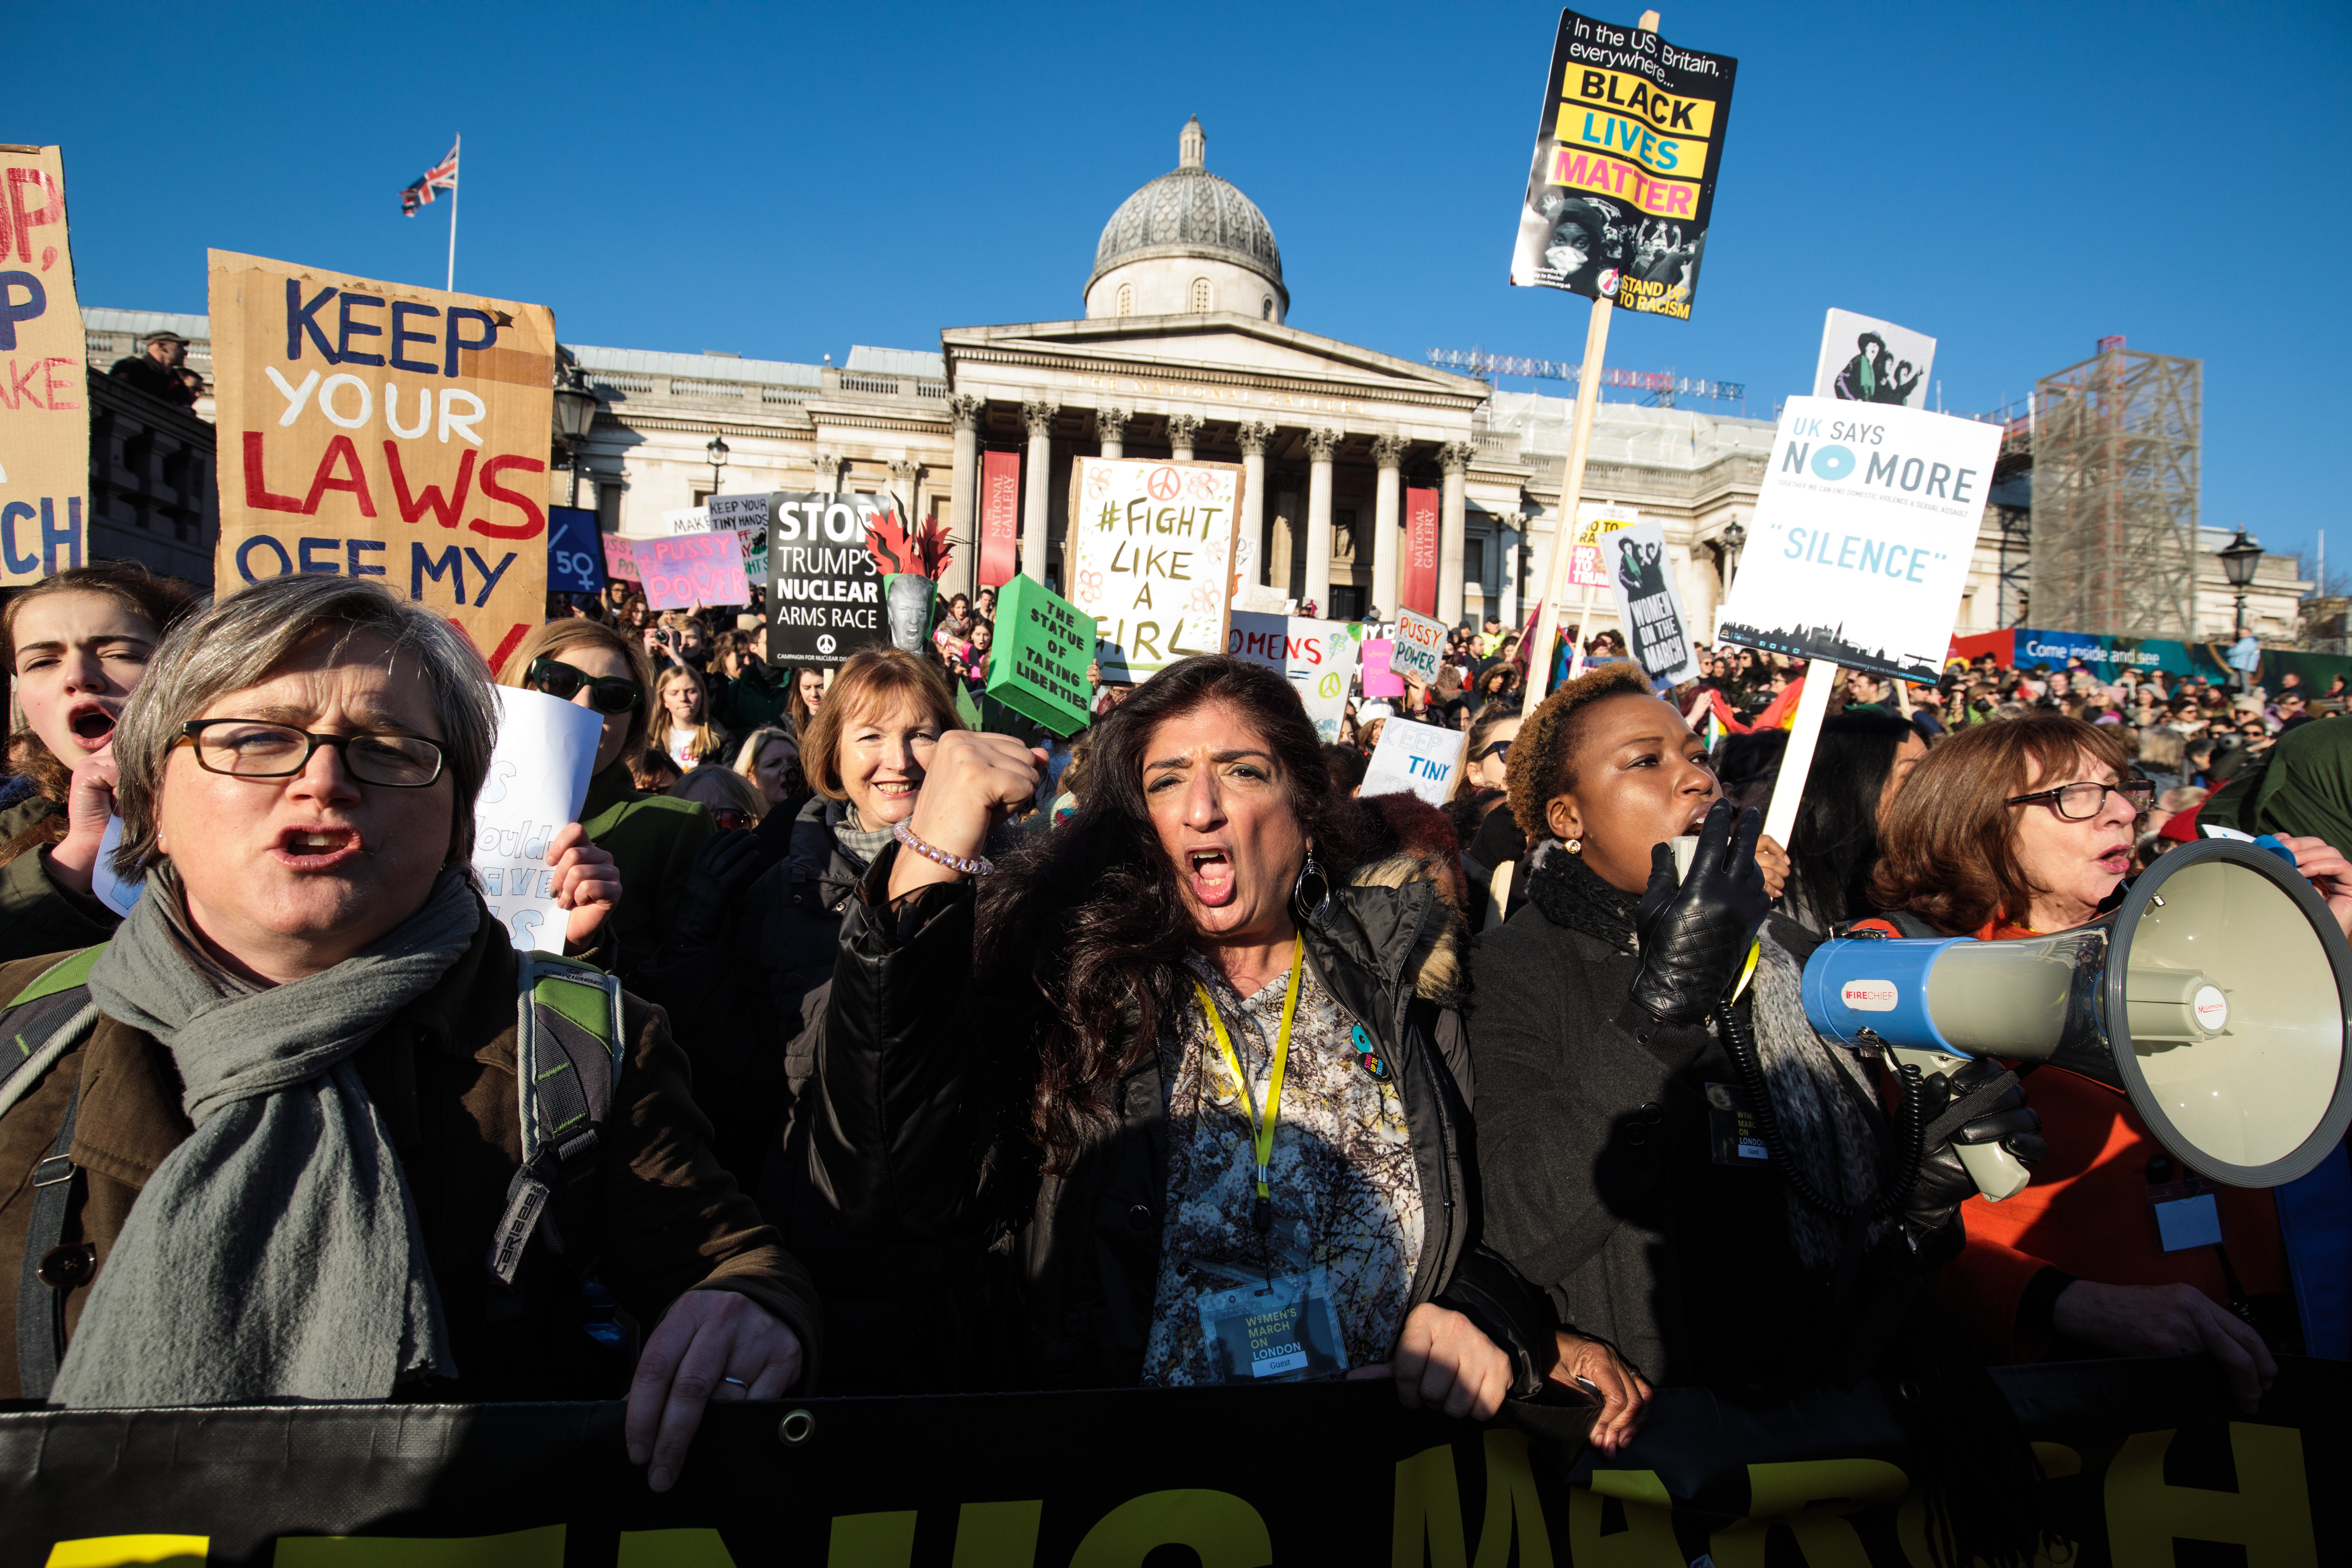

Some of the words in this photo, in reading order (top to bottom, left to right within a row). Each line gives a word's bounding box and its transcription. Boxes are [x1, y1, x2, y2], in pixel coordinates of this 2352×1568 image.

[1570, 42, 1674, 87] everywhere...
[1574, 18, 1589, 39] In
[1596, 25, 1624, 46] the
[1631, 31, 1657, 58] US,
[1662, 44, 1719, 77] Britain,
[1580, 70, 1698, 130] BLACK
[1582, 112, 1679, 170] LIVES
[1553, 150, 1693, 215] MATTER
[1620, 289, 1634, 308] TO
[1636, 295, 1691, 319] RACISM
[1621, 274, 1663, 297] STAND
[1667, 284, 1686, 301] UP
[286, 278, 498, 377] KEEP
[265, 366, 487, 447] YOUR
[1134, 380, 1250, 402] NATIONAL
[1793, 417, 1823, 437] UK
[1830, 421, 1885, 445] SAYS
[243, 431, 546, 540] LAWS
[1782, 441, 1856, 481] NO
[1865, 451, 1977, 504] MORE
[710, 501, 739, 515] KEEP
[741, 498, 767, 513] YOUR
[992, 474, 1003, 537] NATIONAL
[1001, 474, 1014, 538] GALLERY
[1778, 479, 1807, 489] TOGETHER
[1819, 486, 1831, 494] CAN
[1847, 490, 1877, 500] DOMESTIC
[1880, 495, 1909, 506] VIOLENCE
[1916, 501, 1939, 512] SEXUAL
[1940, 506, 1968, 517] ASSAULT
[711, 515, 736, 531] TINY
[1094, 497, 1224, 542] #FIGHT
[654, 535, 732, 562] PUSSY
[1414, 508, 1424, 567] NATIONAL
[1423, 509, 1435, 568] GALLERY
[1576, 547, 1595, 560] NO
[411, 541, 518, 608] MY
[778, 546, 877, 576] TRUMP'S
[1110, 540, 1194, 581] LIKE
[1575, 559, 1593, 572] TO
[648, 566, 749, 609] POWER
[777, 578, 878, 603] NUCLEAR
[1133, 581, 1153, 610] A
[777, 606, 826, 627] ARMS
[832, 608, 877, 628] RACE
[1047, 600, 1075, 628] THE
[1630, 591, 1674, 627] WOMEN
[1031, 608, 1084, 651] STATUE
[1229, 628, 1322, 665] OMENS
[1399, 616, 1443, 650] PUSSY
[1639, 624, 1657, 646] ON
[1654, 617, 1678, 639] THE
[1025, 645, 1080, 687] TAKING
[1047, 639, 1067, 659] OF
[1396, 641, 1435, 675] POWER
[1643, 635, 1686, 673] MARCH
[2026, 640, 2068, 659] Come
[2069, 643, 2108, 662] inside
[2109, 648, 2135, 663] and
[2136, 652, 2160, 666] see
[1016, 660, 1088, 711] LIBERTIES
[1382, 720, 1443, 756] KEEP
[1409, 755, 1452, 781] TINY
[1845, 990, 1894, 1000] FIRECHIEF
[2198, 1003, 2224, 1014] MEGAPHONE
[1364, 1054, 1373, 1069] STAND
[1370, 1064, 1377, 1073] UP
[1248, 1321, 1290, 1338] MARCH
[1251, 1338, 1268, 1349] ON
[1253, 1341, 1301, 1361] LONDON
[1270, 1359, 1291, 1369] Guest
